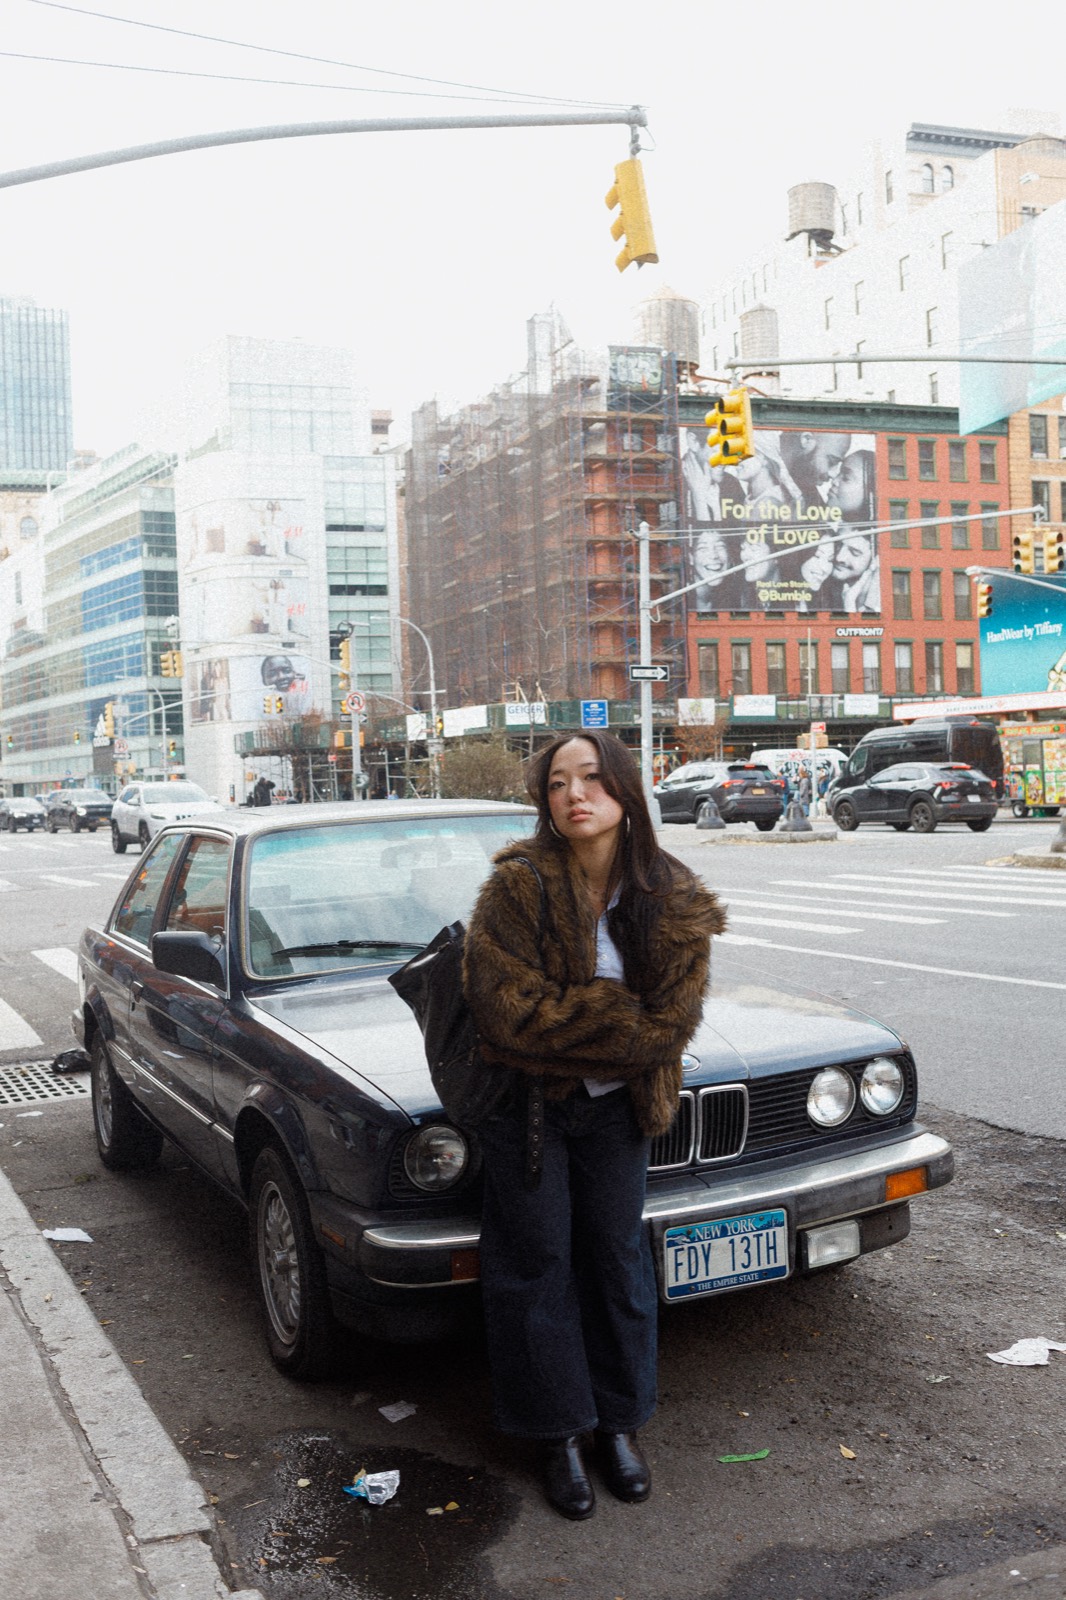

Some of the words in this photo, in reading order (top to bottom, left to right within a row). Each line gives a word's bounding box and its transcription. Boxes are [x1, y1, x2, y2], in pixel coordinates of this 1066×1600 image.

[721, 498, 753, 519] For
[758, 500, 791, 520] the
[796, 500, 842, 520] Love
[746, 523, 768, 544] of
[773, 524, 819, 544] Love
[769, 590, 812, 601] Bumble
[986, 628, 1024, 643] HardWear
[1024, 624, 1034, 640] by
[1034, 621, 1063, 637] Tiffany
[695, 1223, 722, 1241] NEW
[725, 1218, 757, 1236] YORK
[674, 1243, 711, 1282] FDY
[728, 1231, 777, 1271] 13TH
[697, 1283, 712, 1291] THE
[713, 1276, 738, 1288] EMPIRE
[738, 1273, 759, 1283] STATE
